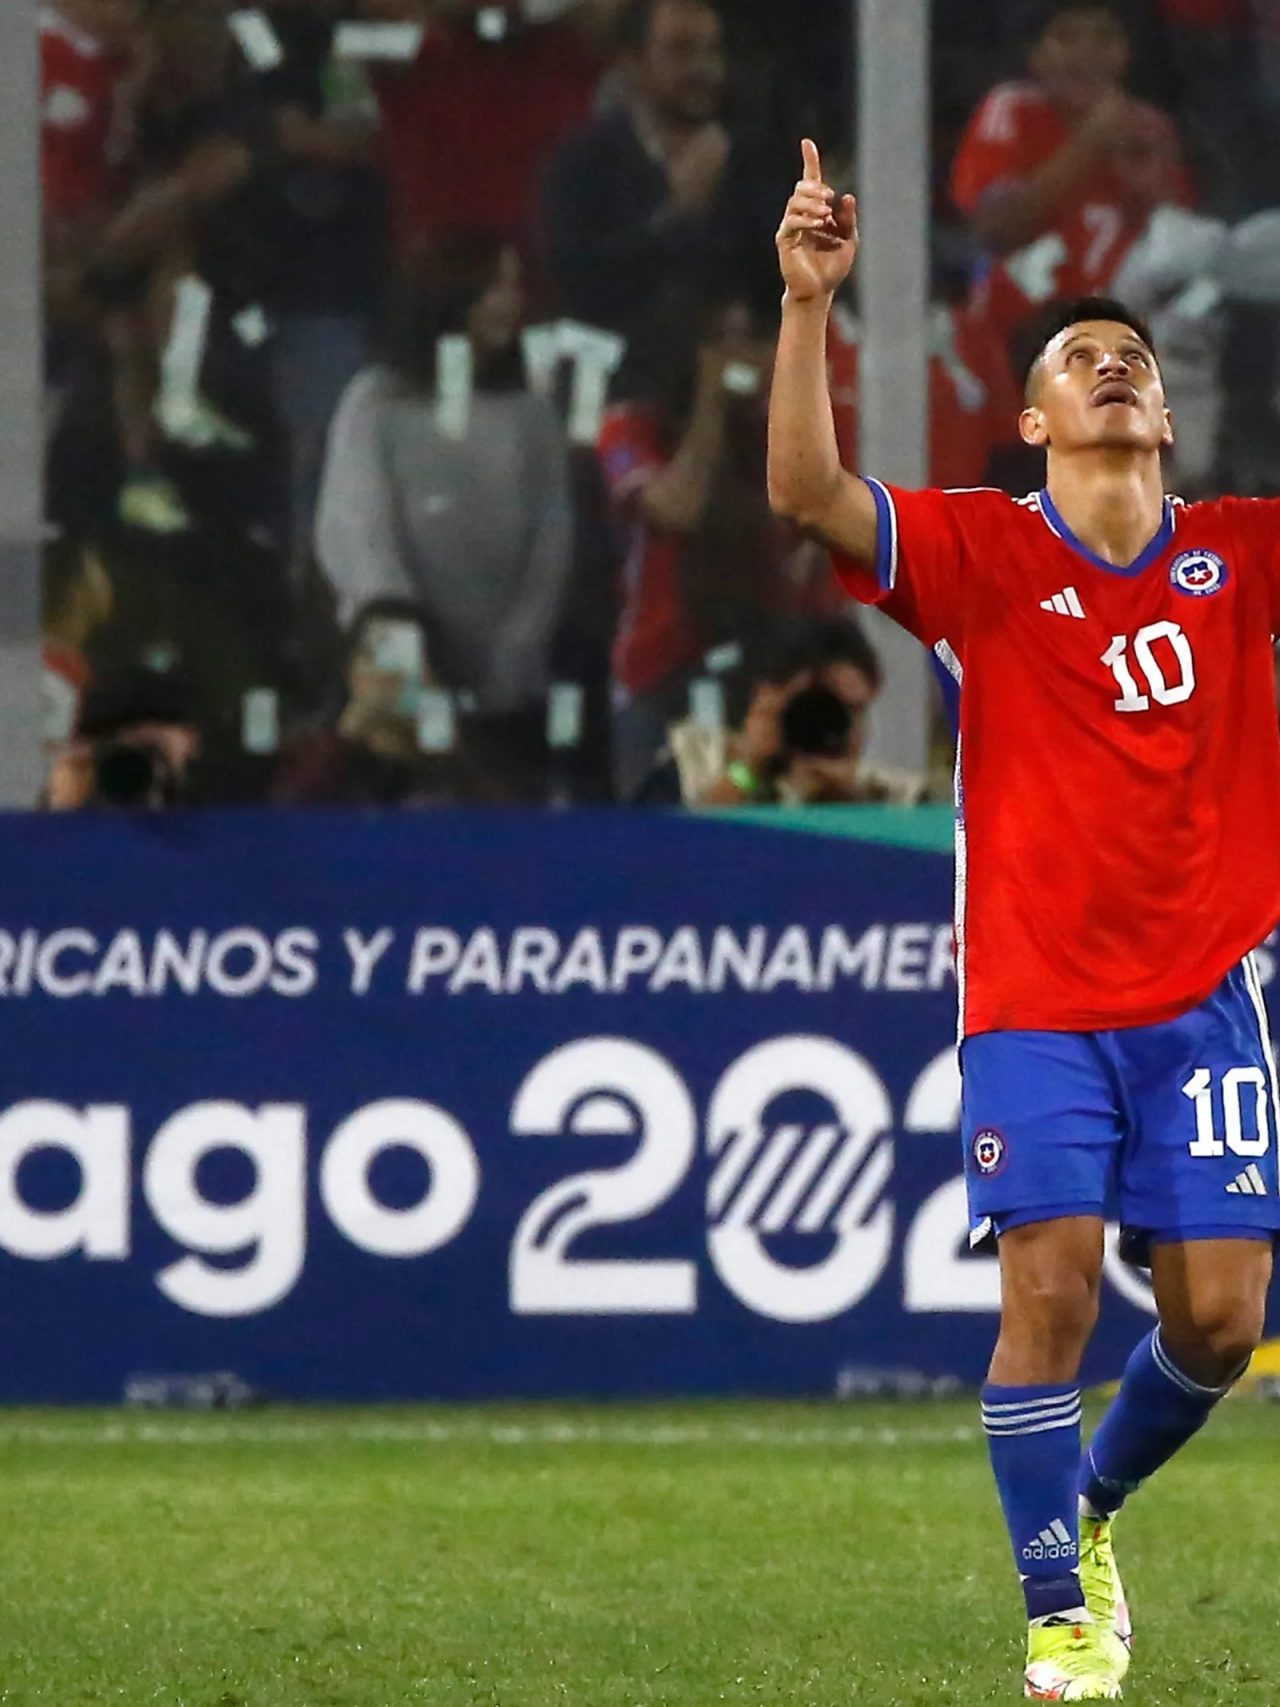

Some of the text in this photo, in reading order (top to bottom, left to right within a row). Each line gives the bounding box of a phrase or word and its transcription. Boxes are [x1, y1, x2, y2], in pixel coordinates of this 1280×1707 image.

[1100, 620, 1196, 712] 10
[343, 927, 395, 995] Y
[1181, 1066, 1270, 1157] 10
[1022, 1541, 1077, 1560] adidas
